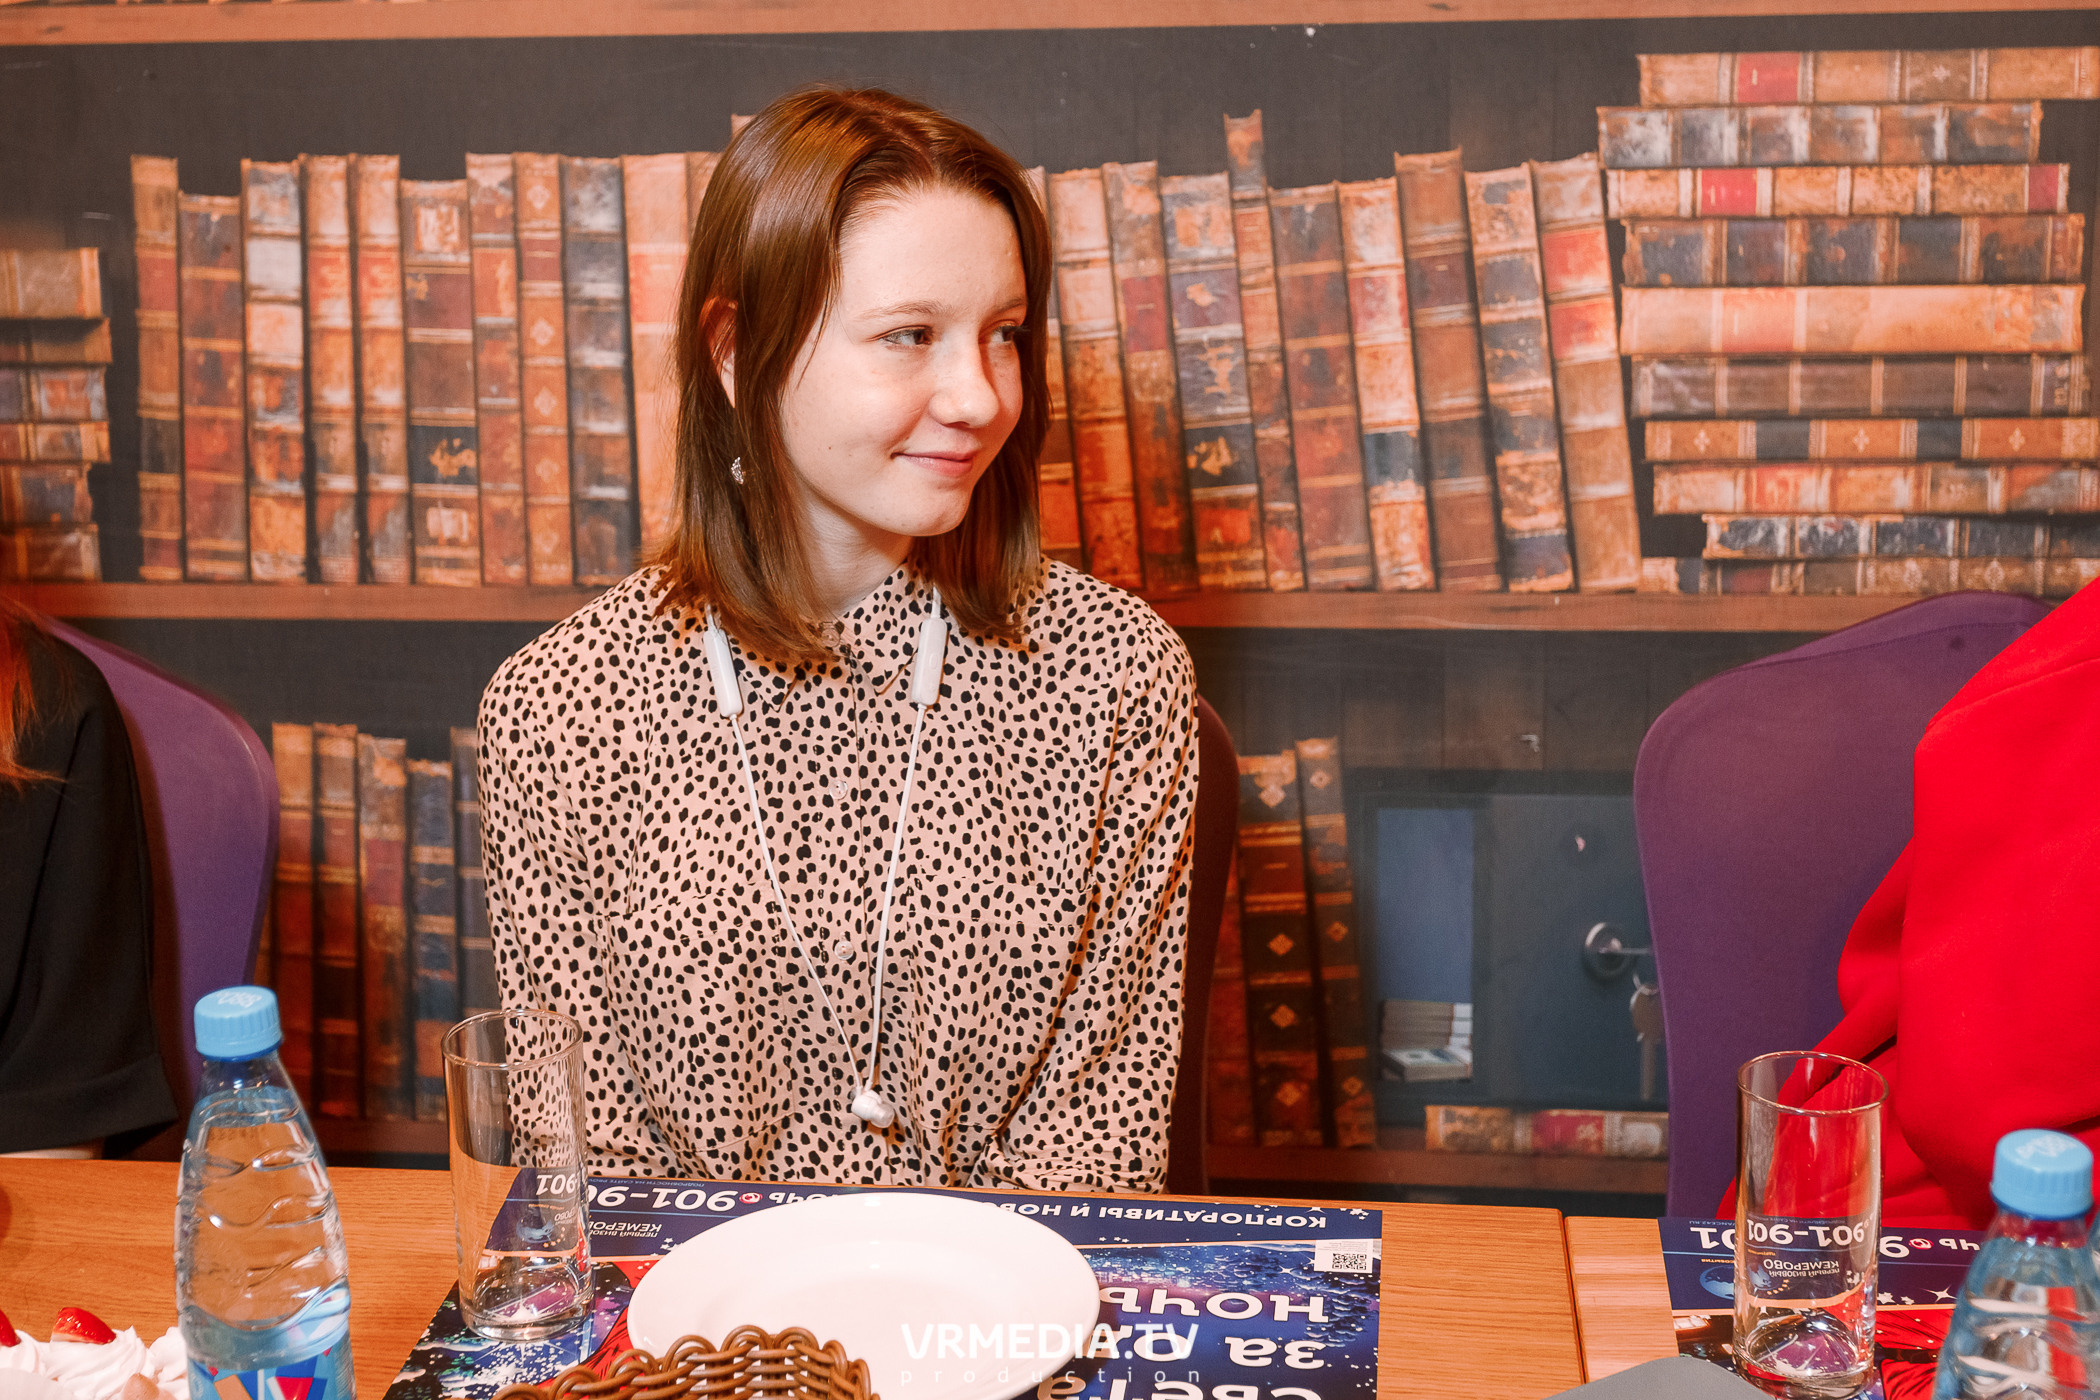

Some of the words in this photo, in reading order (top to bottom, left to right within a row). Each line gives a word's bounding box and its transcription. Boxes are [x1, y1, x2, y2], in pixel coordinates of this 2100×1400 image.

[994, 1203, 1062, 1216] НОВ
[1070, 1205, 1090, 1218] И
[1099, 1207, 1327, 1229] КОРПОРАТИВЫ
[1746, 1219, 1865, 1247] 901-901
[1763, 1258, 1840, 1271] КЕМЕРОВО
[1808, 1268, 1840, 1278] ПЕРВЫЙ
[1098, 1286, 1329, 1323] ночь
[1084, 1326, 1192, 1362] од
[1223, 1336, 1327, 1370] за
